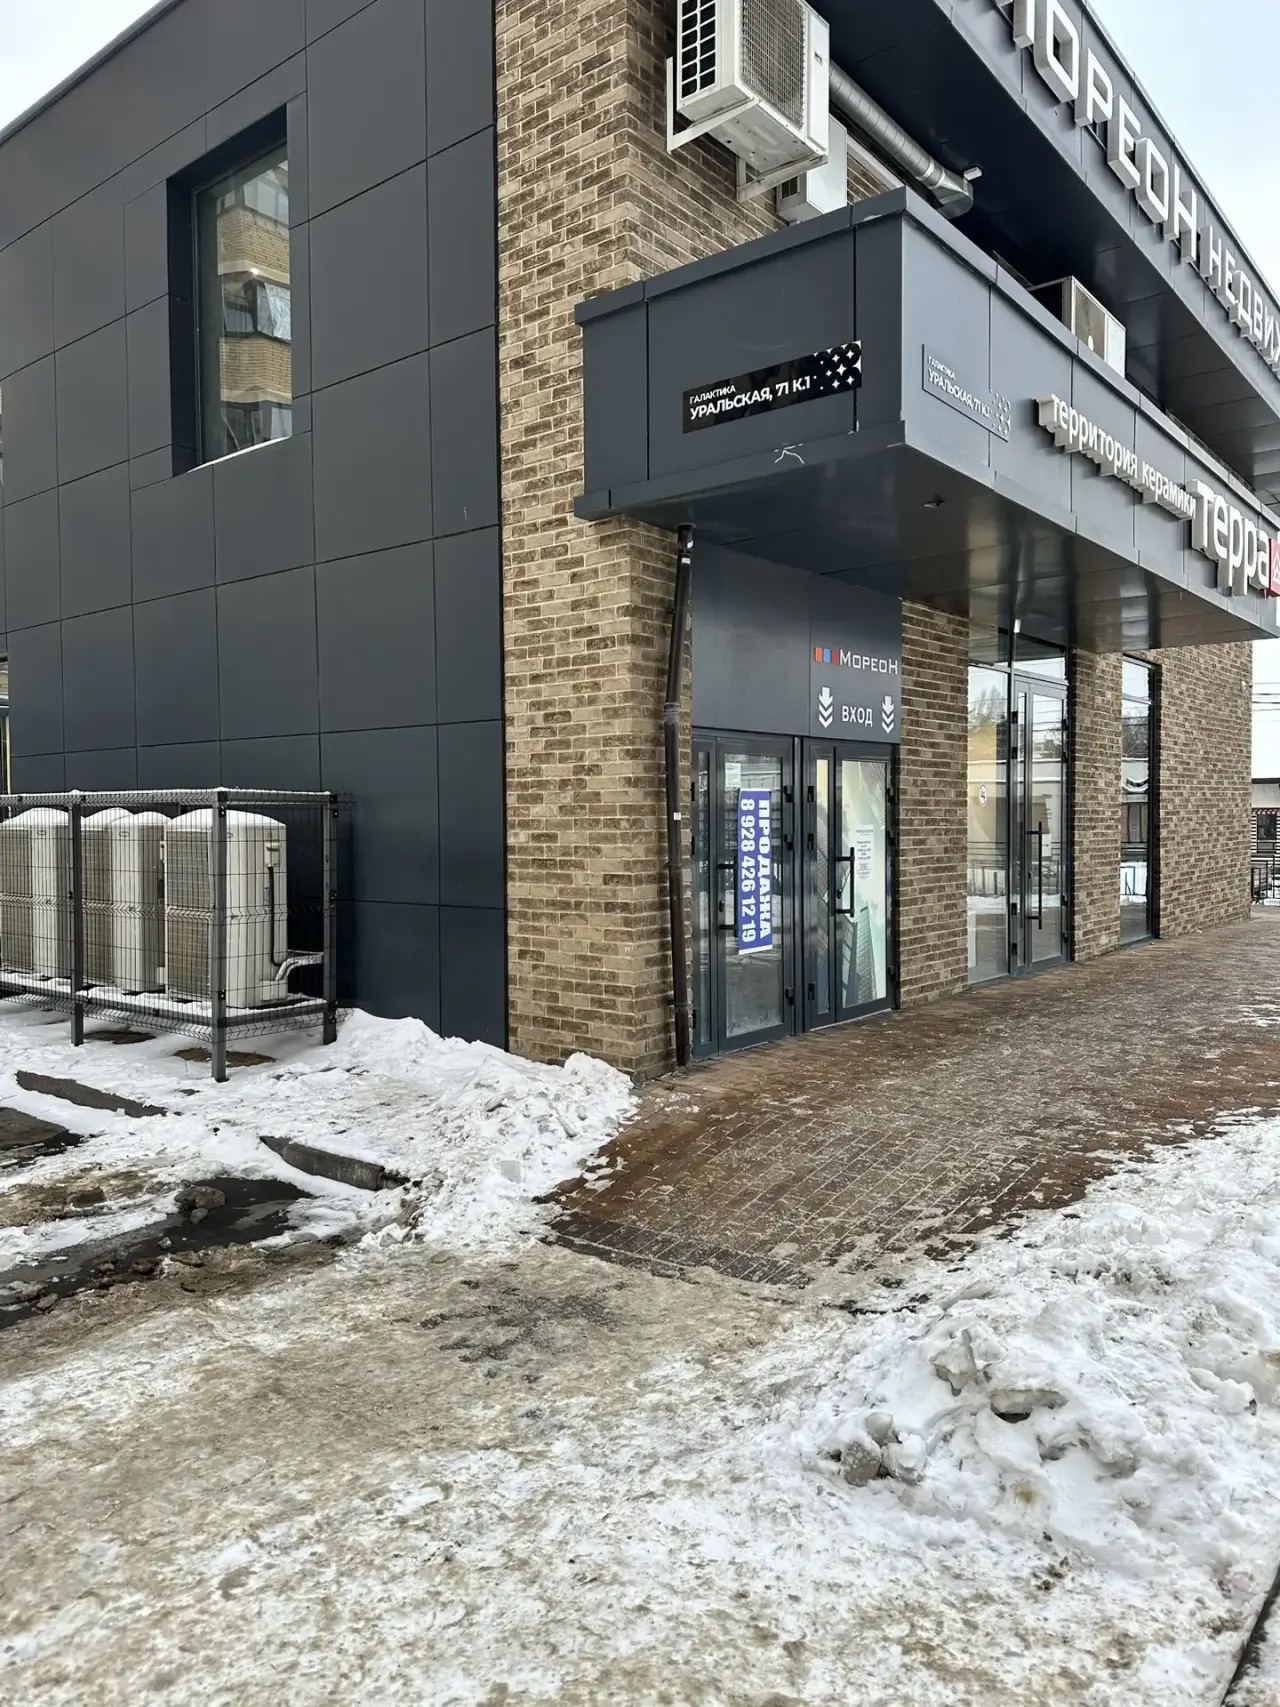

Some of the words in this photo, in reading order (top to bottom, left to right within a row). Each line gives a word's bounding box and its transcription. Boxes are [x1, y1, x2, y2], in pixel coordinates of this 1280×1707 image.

[689, 385, 736, 404] ГАЛАКТИКА
[689, 387, 773, 420] УРАЛЬСКАЯ,
[776, 381, 789, 397] 71
[1051, 393, 1138, 479] территория
[1141, 460, 1196, 520] керамики
[841, 705, 873, 727] ВХОД
[740, 798, 755, 811] 8
[740, 815, 755, 852] 928
[741, 855, 756, 893] 426
[758, 799, 771, 940] ПРОДАЖА
[741, 895, 756, 917] 12
[741, 919, 757, 943] 19
